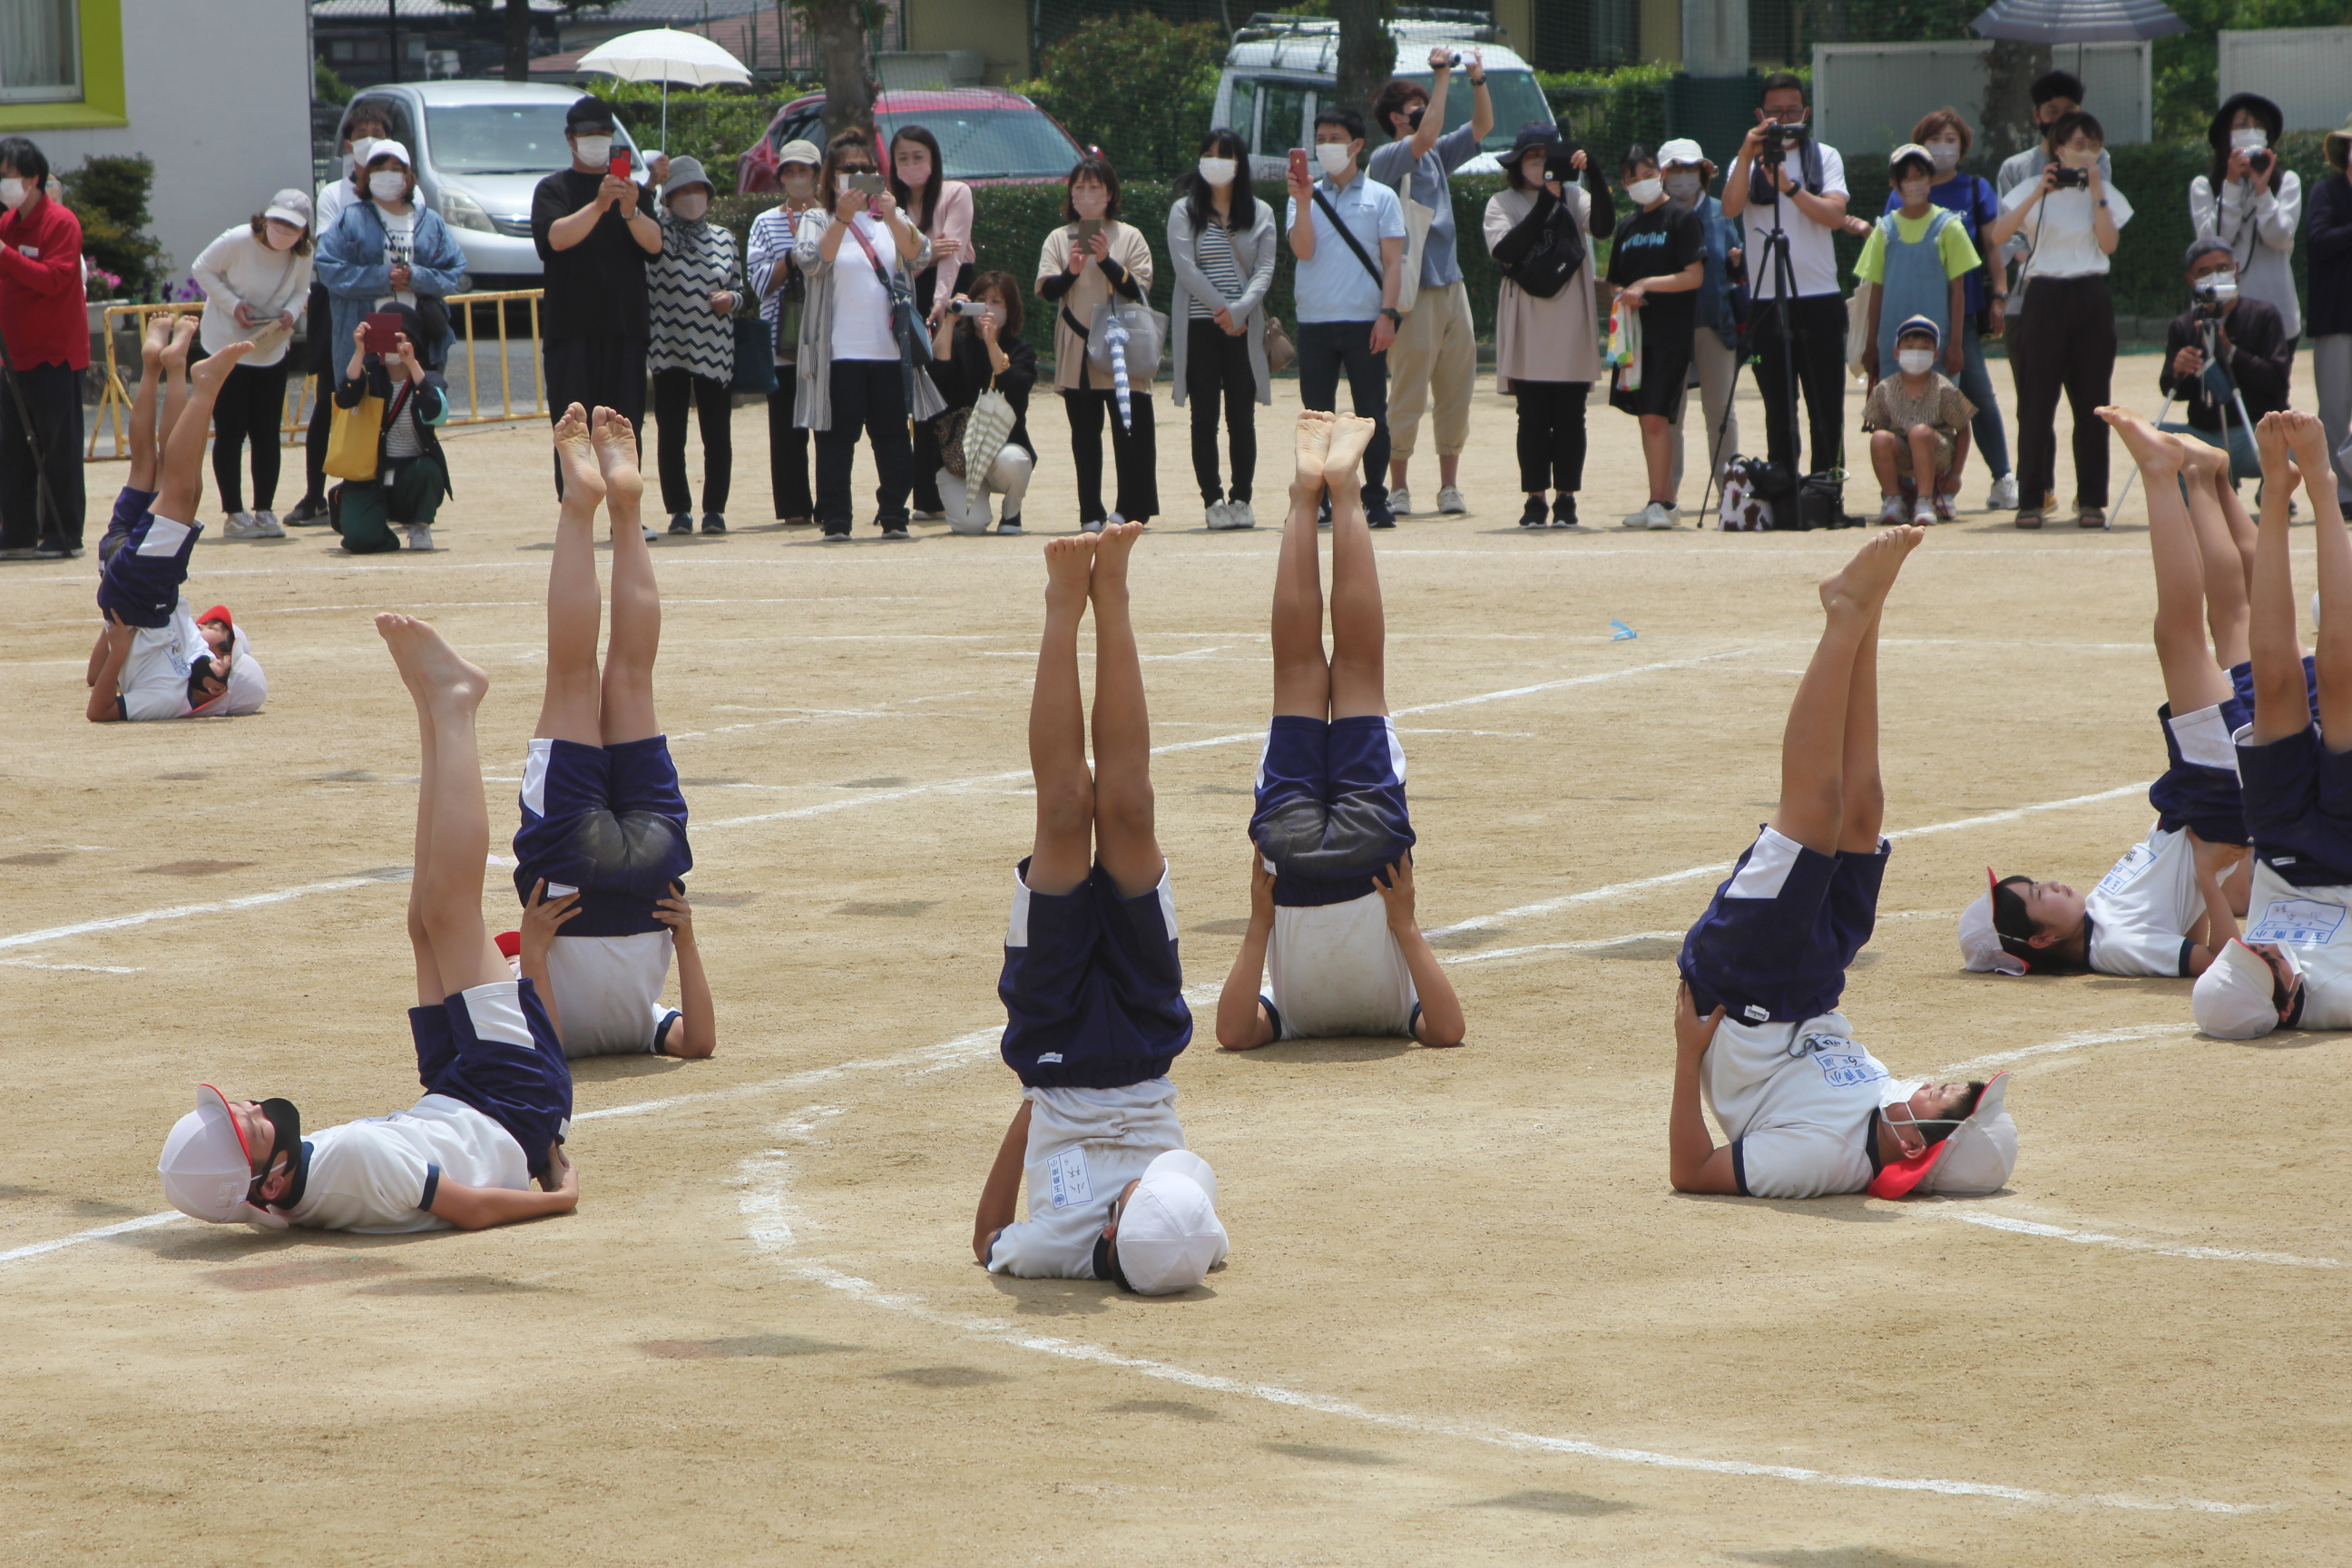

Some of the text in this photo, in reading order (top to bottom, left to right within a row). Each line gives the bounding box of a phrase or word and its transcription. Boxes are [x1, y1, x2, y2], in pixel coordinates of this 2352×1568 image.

[2256, 929, 2326, 941] 玉島南小
[1049, 1159, 1063, 1194] 玉島南小
